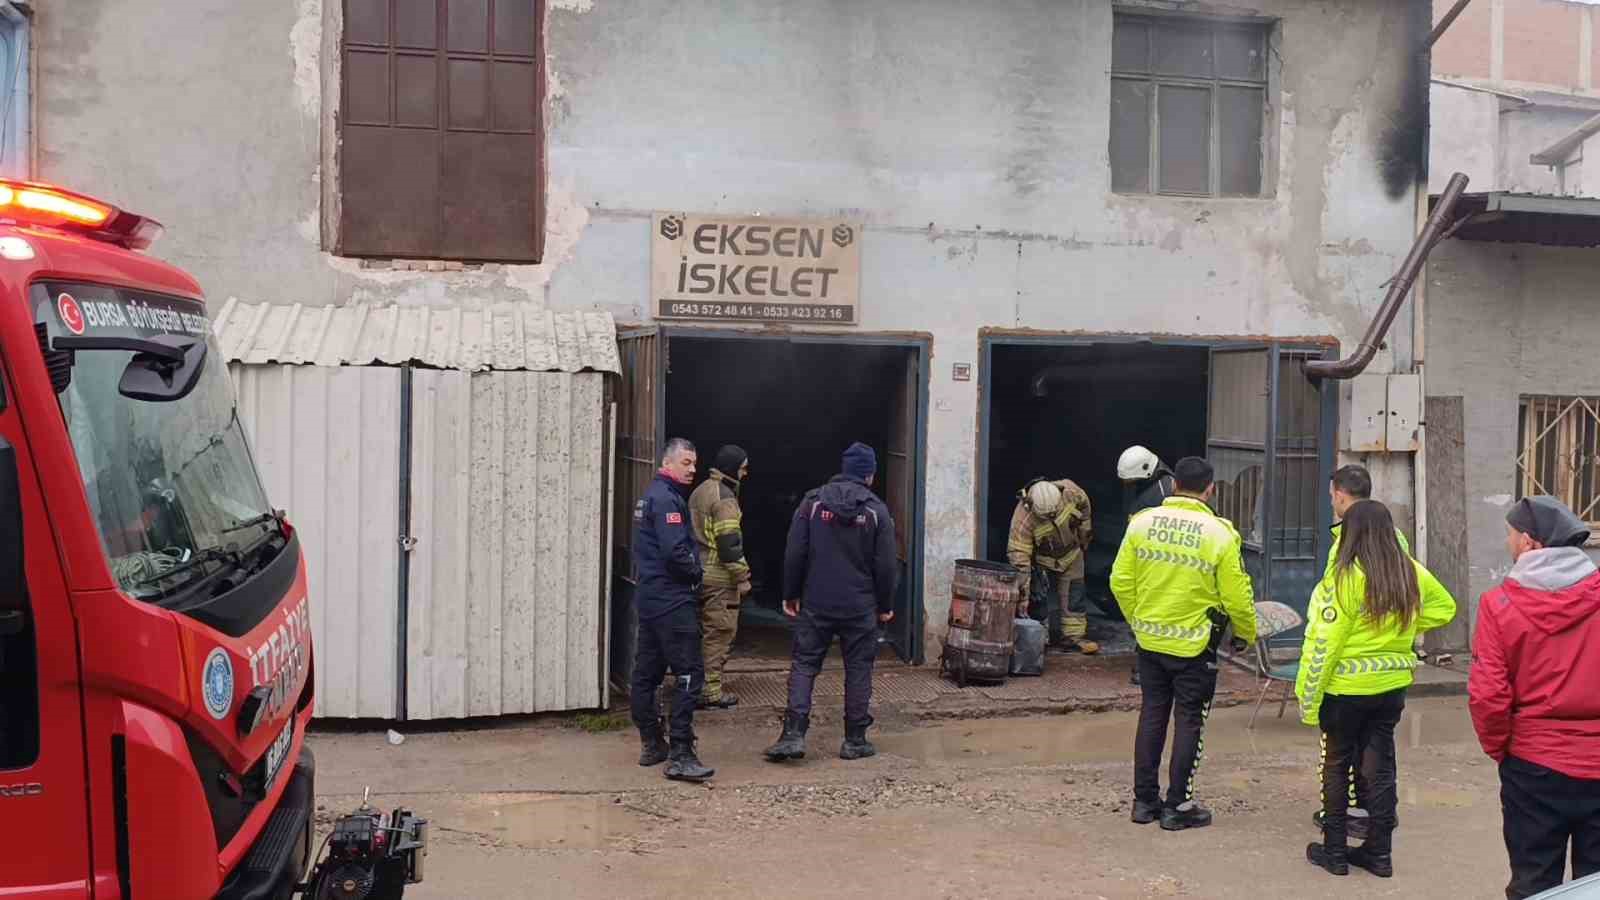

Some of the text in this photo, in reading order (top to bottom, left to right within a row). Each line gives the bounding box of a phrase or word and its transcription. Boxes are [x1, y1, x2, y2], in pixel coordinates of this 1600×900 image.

[693, 223, 825, 258] EKSEN
[677, 255, 839, 297] İSKELET
[81, 301, 128, 327] BURSA
[672, 303, 698, 314] 0543
[702, 305, 721, 316] 572
[740, 305, 753, 316] 41
[763, 307, 788, 318] 0533
[791, 307, 811, 318] 423
[813, 308, 826, 319] 92
[829, 308, 842, 319] 16
[1152, 515, 1204, 535] TRAFİK
[1147, 528, 1201, 549] POLİSİ
[246, 597, 310, 687] İTFAİYE
